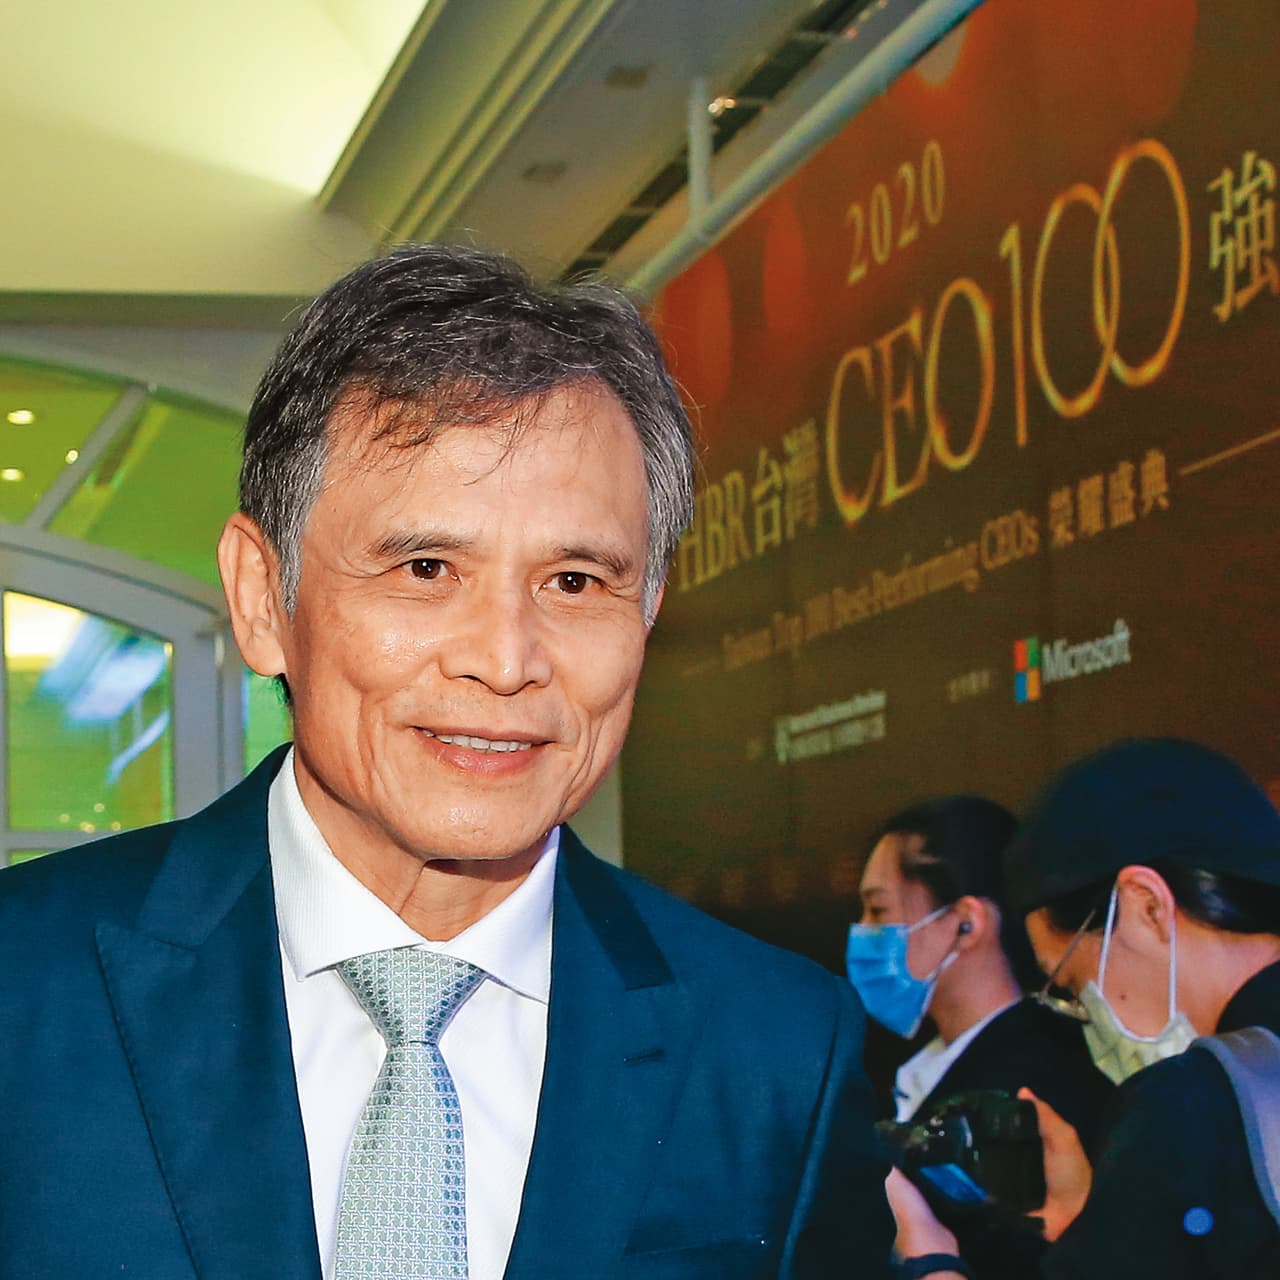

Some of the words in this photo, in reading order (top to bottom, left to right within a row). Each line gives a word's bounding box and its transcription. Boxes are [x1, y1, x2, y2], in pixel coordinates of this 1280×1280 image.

[847, 139, 946, 286] 2020
[981, 508, 1041, 572] CEOs
[1041, 617, 1131, 685] Microsoft
